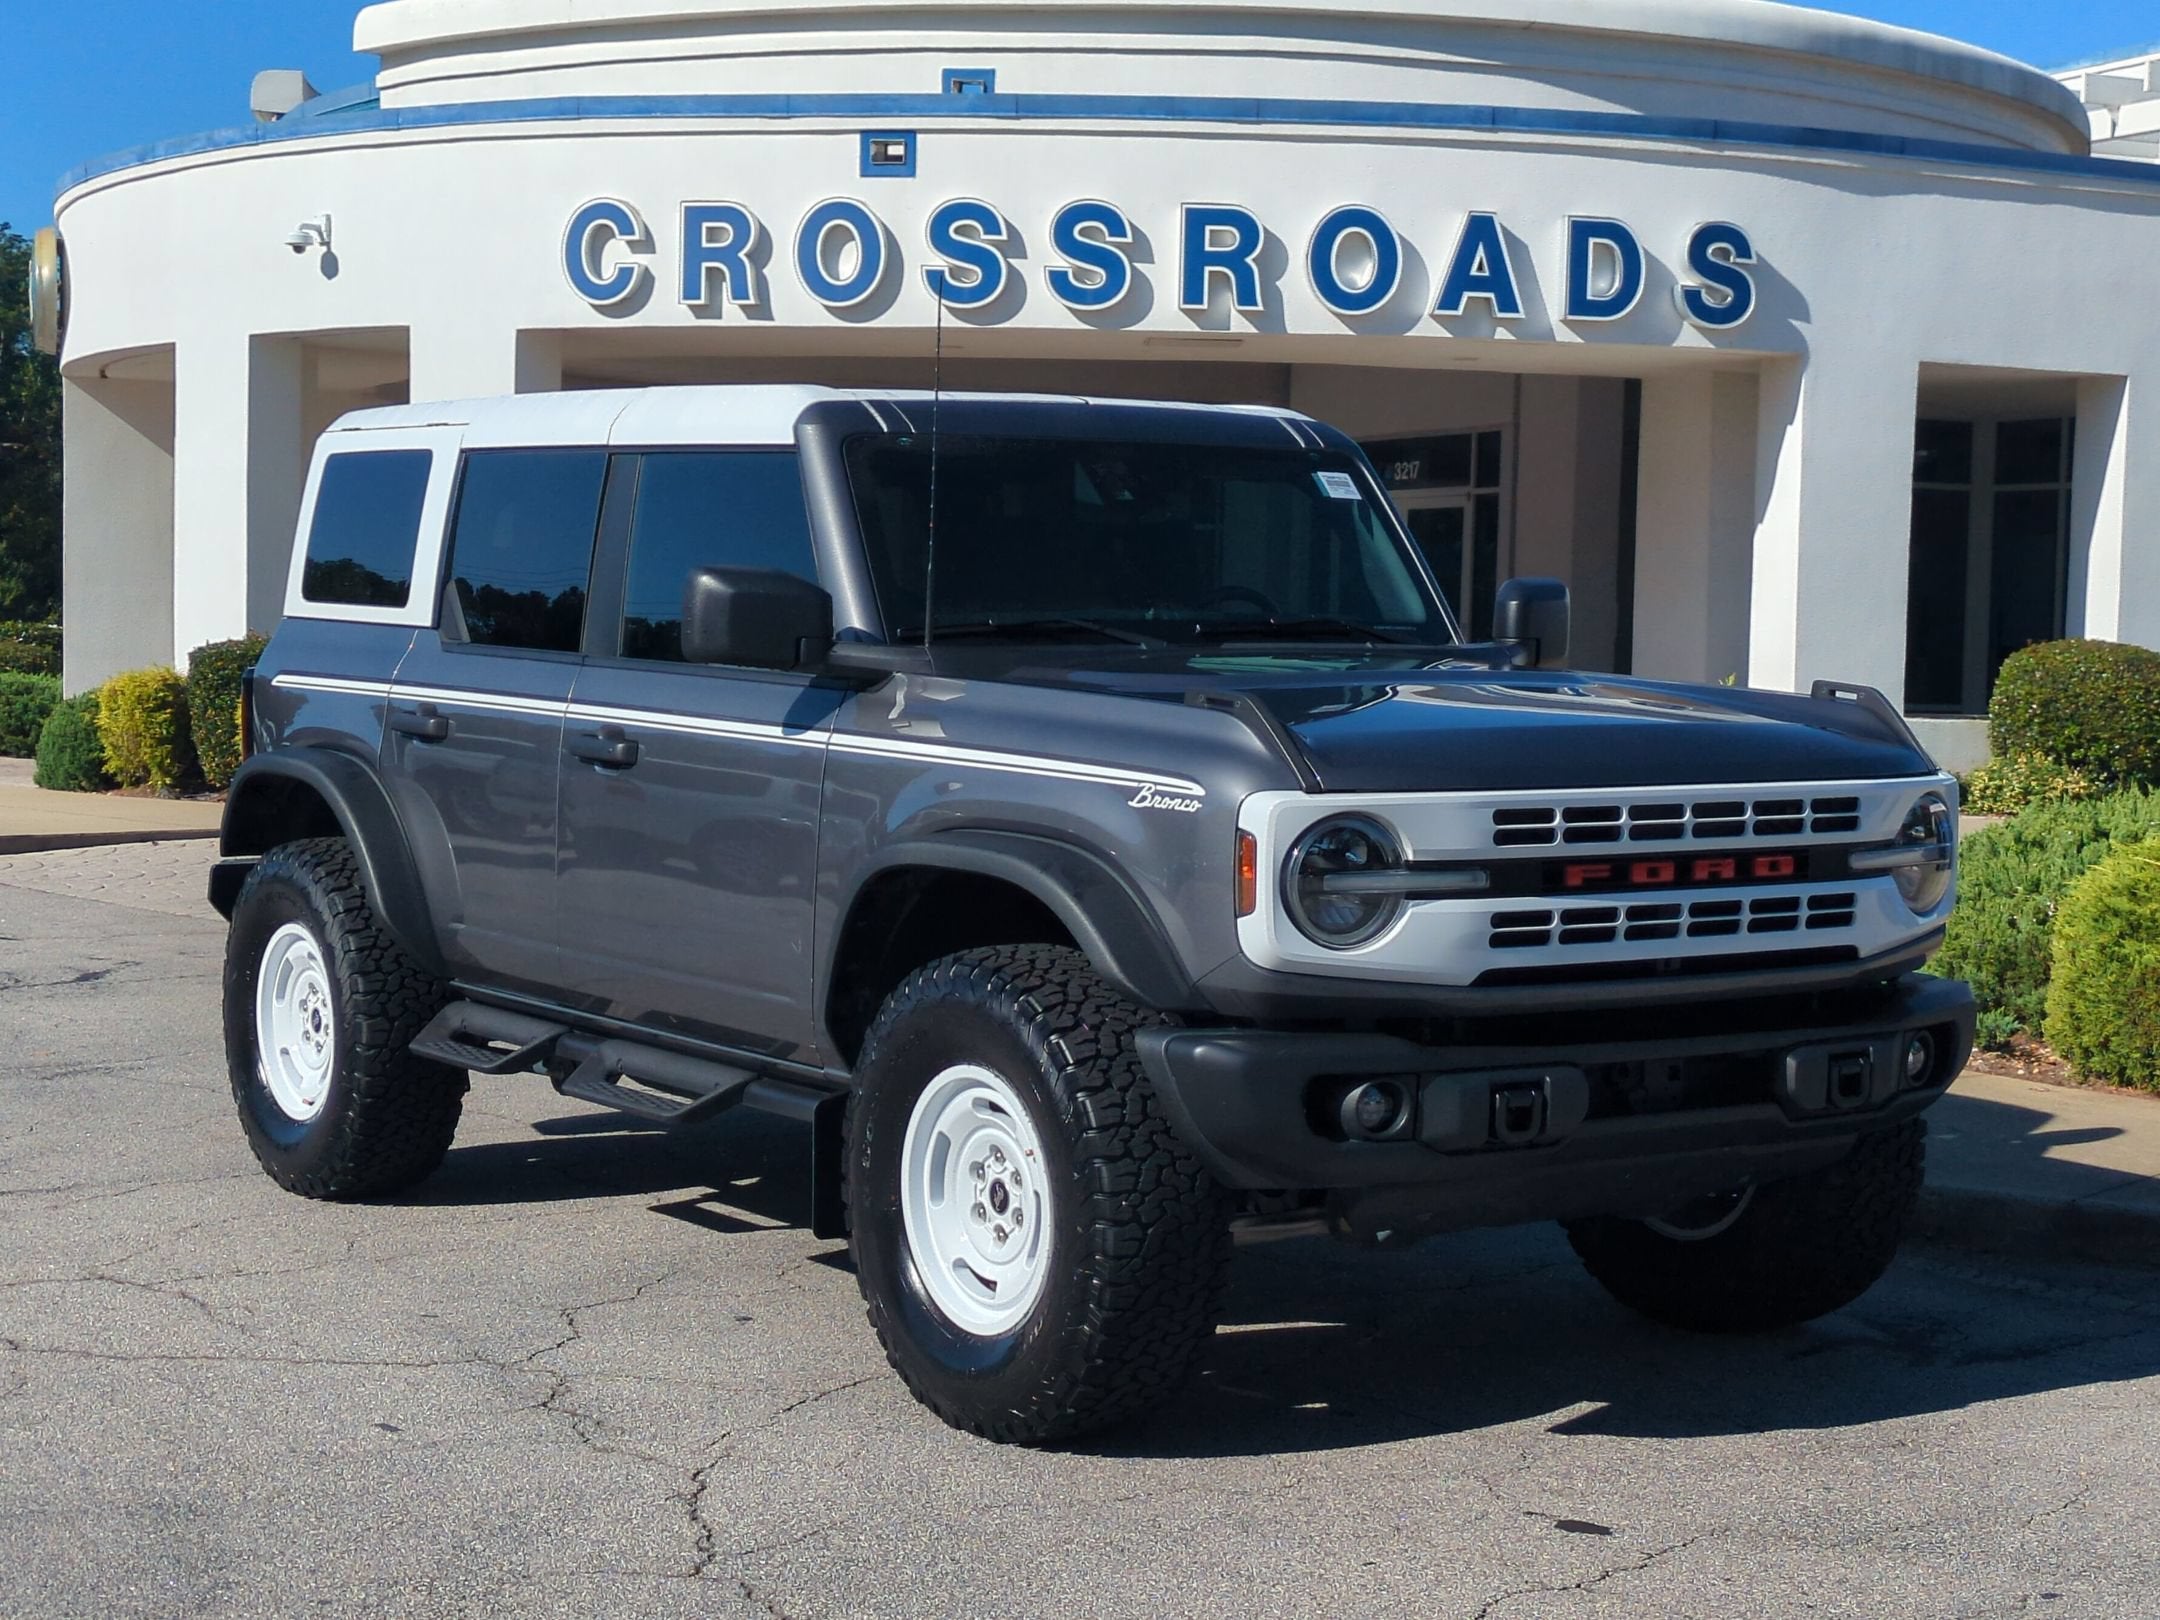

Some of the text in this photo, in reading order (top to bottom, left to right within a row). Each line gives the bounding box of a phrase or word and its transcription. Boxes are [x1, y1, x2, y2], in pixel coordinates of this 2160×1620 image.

[561, 196, 1758, 329] CROSSROADS
[1394, 461, 1420, 480] 3217
[1127, 782, 1203, 812] Bronco
[1564, 855, 1795, 887] FORD
